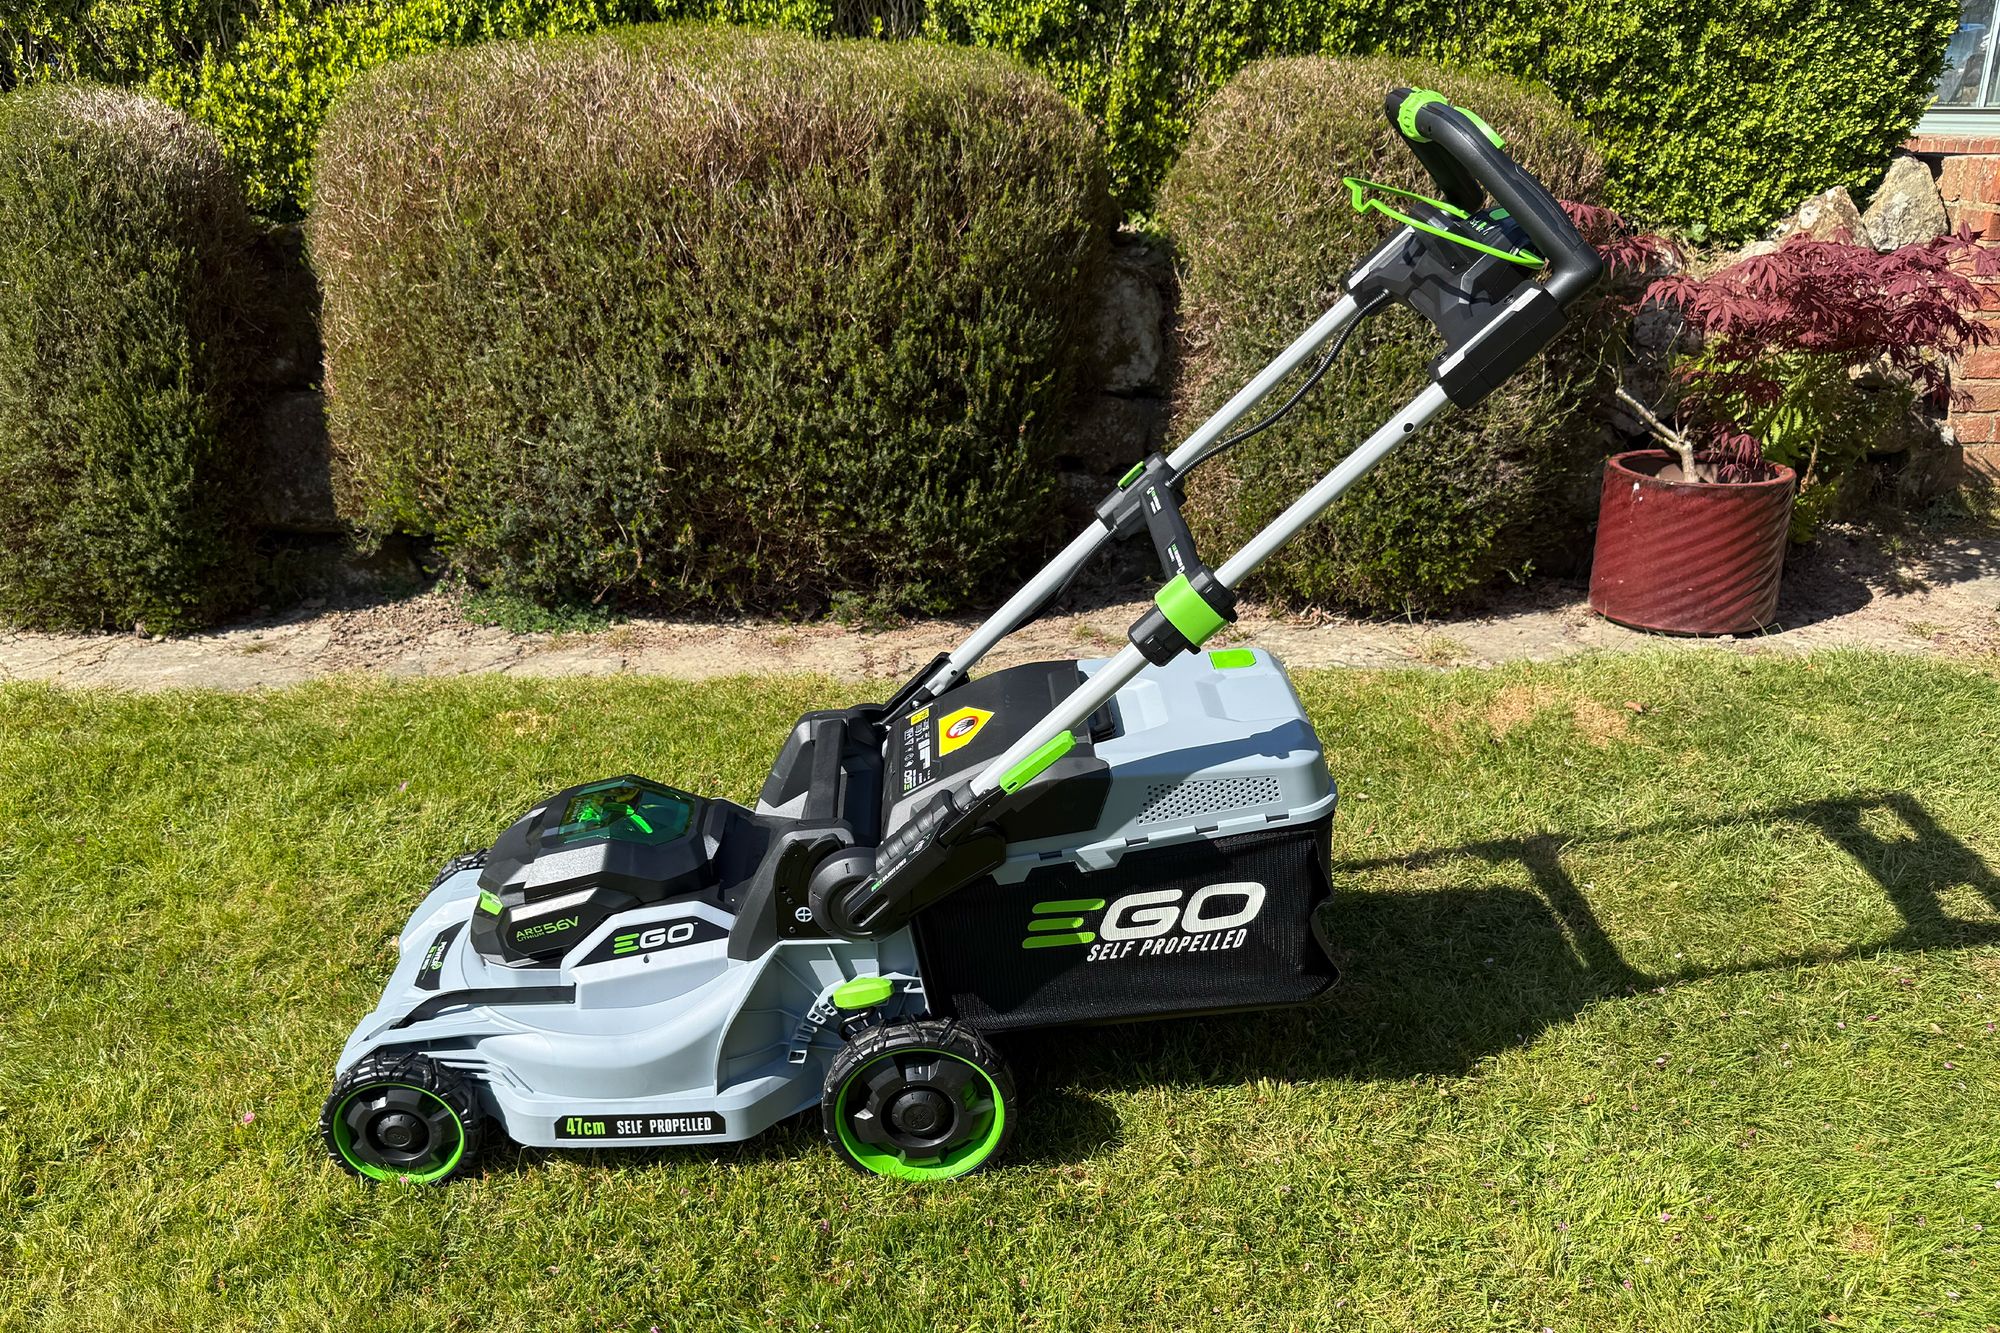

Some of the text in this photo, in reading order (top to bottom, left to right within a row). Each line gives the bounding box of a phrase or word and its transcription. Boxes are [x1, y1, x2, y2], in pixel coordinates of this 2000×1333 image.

[516, 915, 579, 938] ARC 56V
[1022, 882, 1266, 949] EGO
[517, 931, 546, 942] LITHIUM
[613, 922, 695, 954] EGO
[1087, 928, 1247, 962] SELF PROPELLED
[566, 1117, 712, 1136] 47cm SELF PROPELLED
